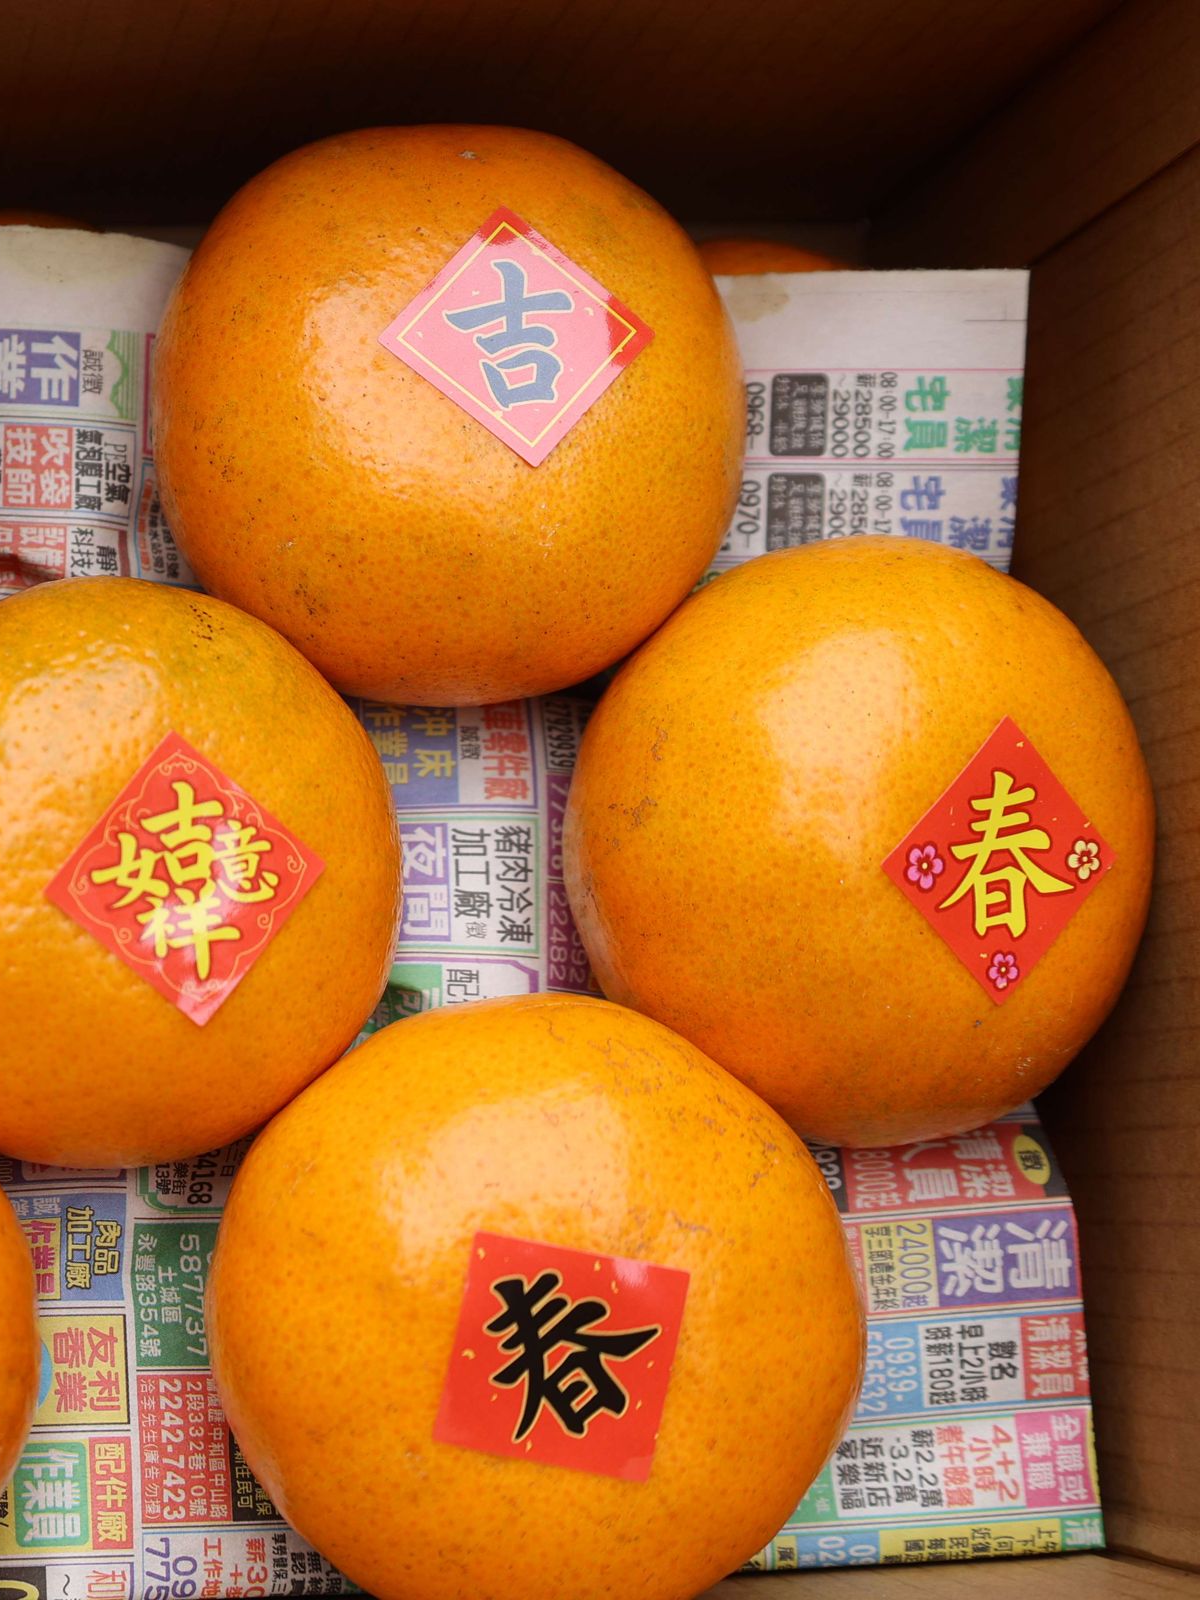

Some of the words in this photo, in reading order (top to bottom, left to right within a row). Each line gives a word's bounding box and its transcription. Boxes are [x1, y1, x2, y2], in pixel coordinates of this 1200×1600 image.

[82, 348, 103, 395] 誠徵
[443, 260, 574, 410] 吉
[853, 373, 877, 459] 薪28500
[3, 427, 36, 505] 技師
[39, 428, 69, 506] 吹袋
[452, 829, 493, 919] 加工廠
[494, 826, 534, 944] 豬肉冷凍
[937, 769, 1075, 938] 春
[549, 891, 567, 981] 22482
[1021, 1146, 1048, 1174] 徵
[64, 1206, 93, 1289] 加工廠
[93, 1219, 123, 1276] 肉品
[864, 1224, 900, 1311] 享三節禮金年終
[894, 1223, 933, 1309] 24000起
[938, 1220, 1074, 1297] 清潔
[134, 1233, 160, 1357] 永豐路354號
[158, 1266, 182, 1324] 土城區
[179, 1233, 207, 1356] 587737
[485, 1270, 661, 1441] 春
[885, 1337, 919, 1402] 0939-
[921, 1326, 960, 1407] 時薪180起
[956, 1324, 990, 1403] 早上2小時
[988, 1341, 1018, 1381] 數名
[1027, 1316, 1076, 1398] 清潔員
[140, 1378, 162, 1520] 洽李先生(廣告勿擾)
[159, 1378, 185, 1522] 2242-7423
[184, 1381, 206, 1518] 2段332巷10號
[833, 1439, 866, 1511] 家樂福
[858, 1436, 892, 1508] 近新店
[910, 1428, 942, 1508] 薪2.2萬
[935, 1424, 975, 1509] 煮午晚餐
[971, 1436, 1000, 1492] 小時
[990, 1424, 1020, 1503] 4+2
[1020, 1431, 1056, 1490] 兼職
[1050, 1414, 1087, 1503] 全職或
[20, 1447, 80, 1542] 作業員
[93, 1442, 127, 1542] 配件廠
